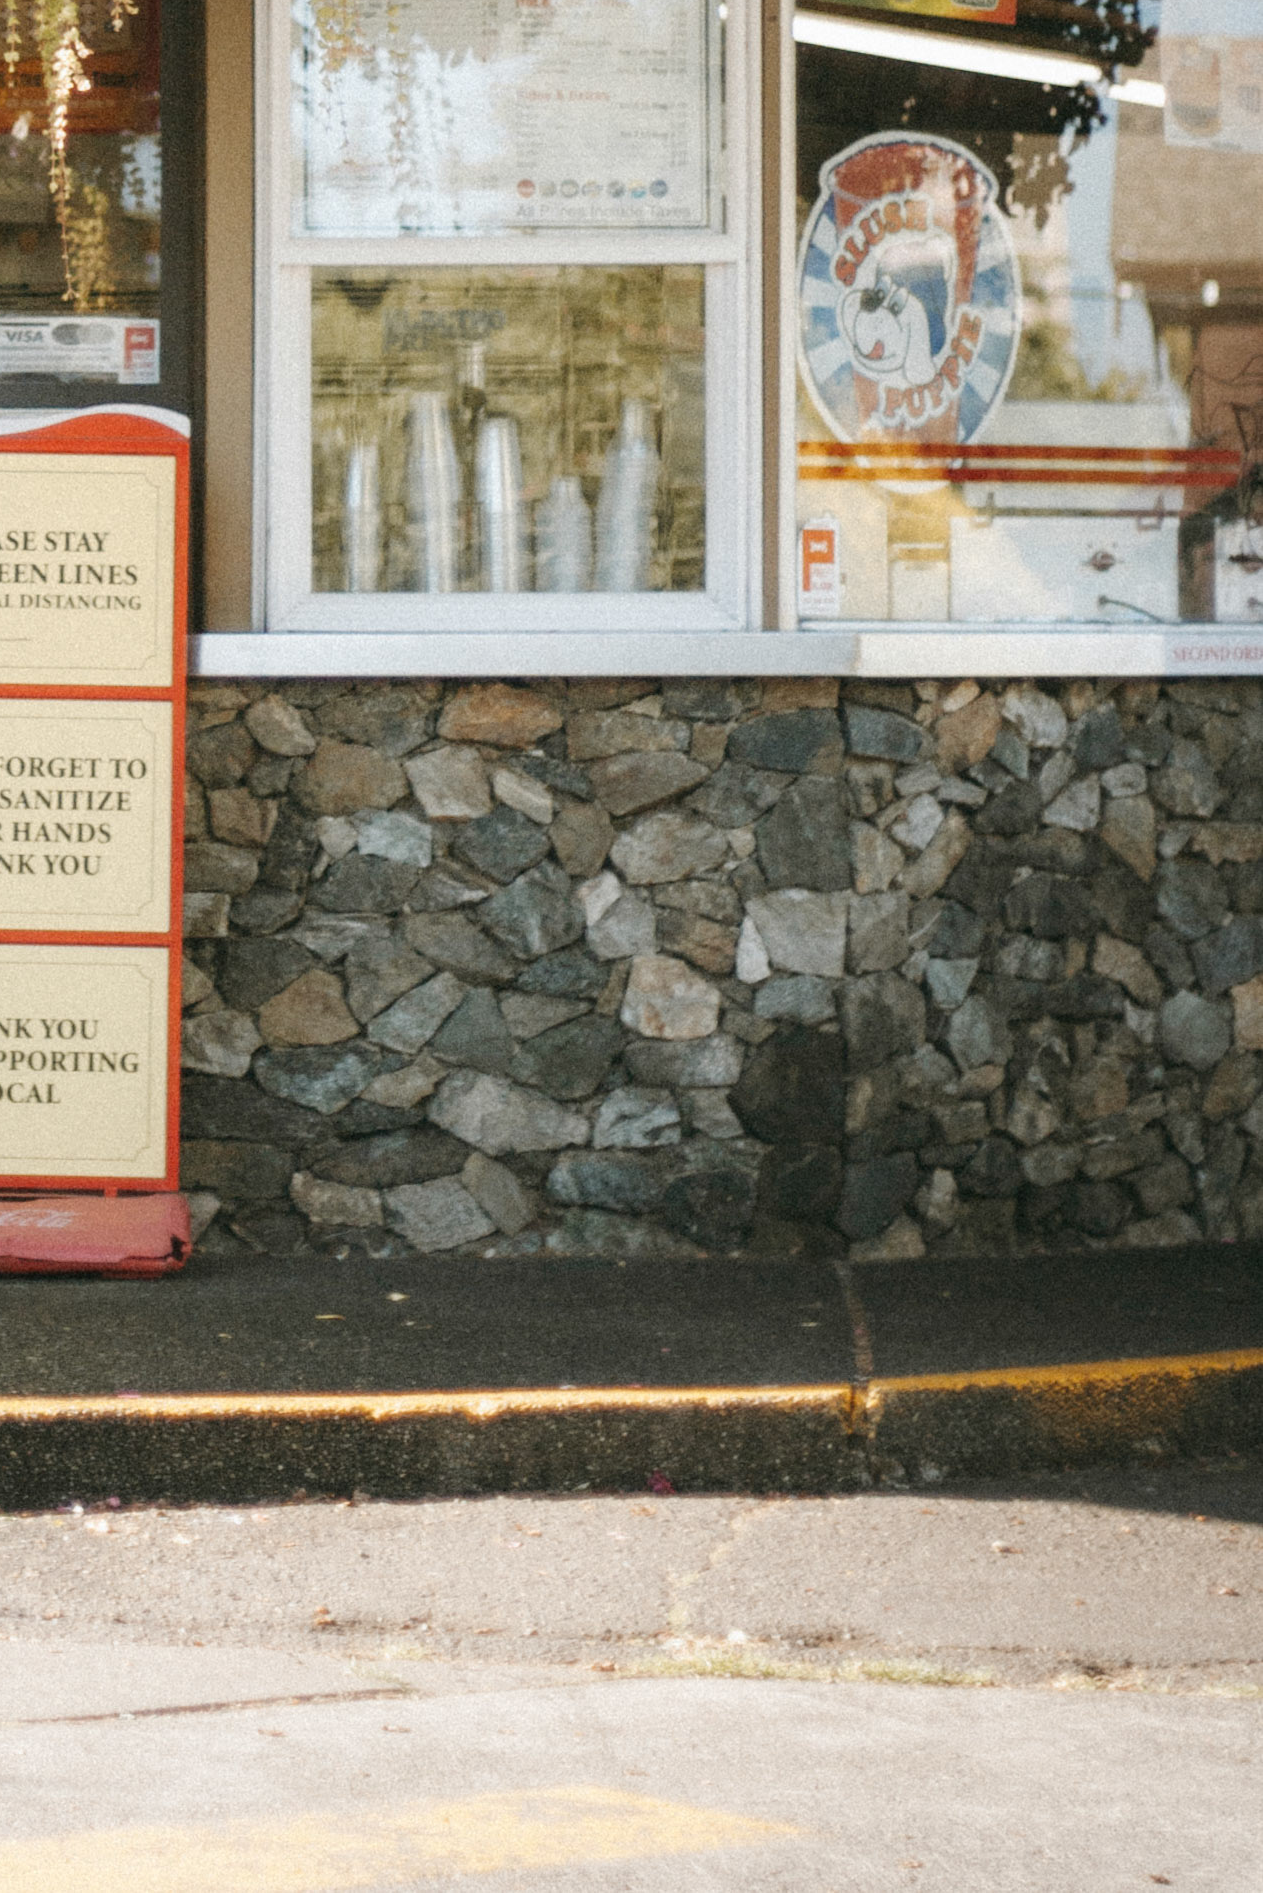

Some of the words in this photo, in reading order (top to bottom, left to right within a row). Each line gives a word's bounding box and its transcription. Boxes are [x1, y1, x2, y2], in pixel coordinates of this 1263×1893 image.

[4, 330, 44, 344] VISA
[44, 531, 109, 553] STAY
[59, 564, 139, 586] LINES
[20, 594, 142, 611] DISTANCING
[1173, 646, 1231, 662] SECOND
[1233, 646, 1263, 662] ORD
[109, 758, 148, 780] TO
[13, 822, 112, 844] HANDS
[44, 855, 102, 876] YOU
[40, 1018, 100, 1040] YOU
